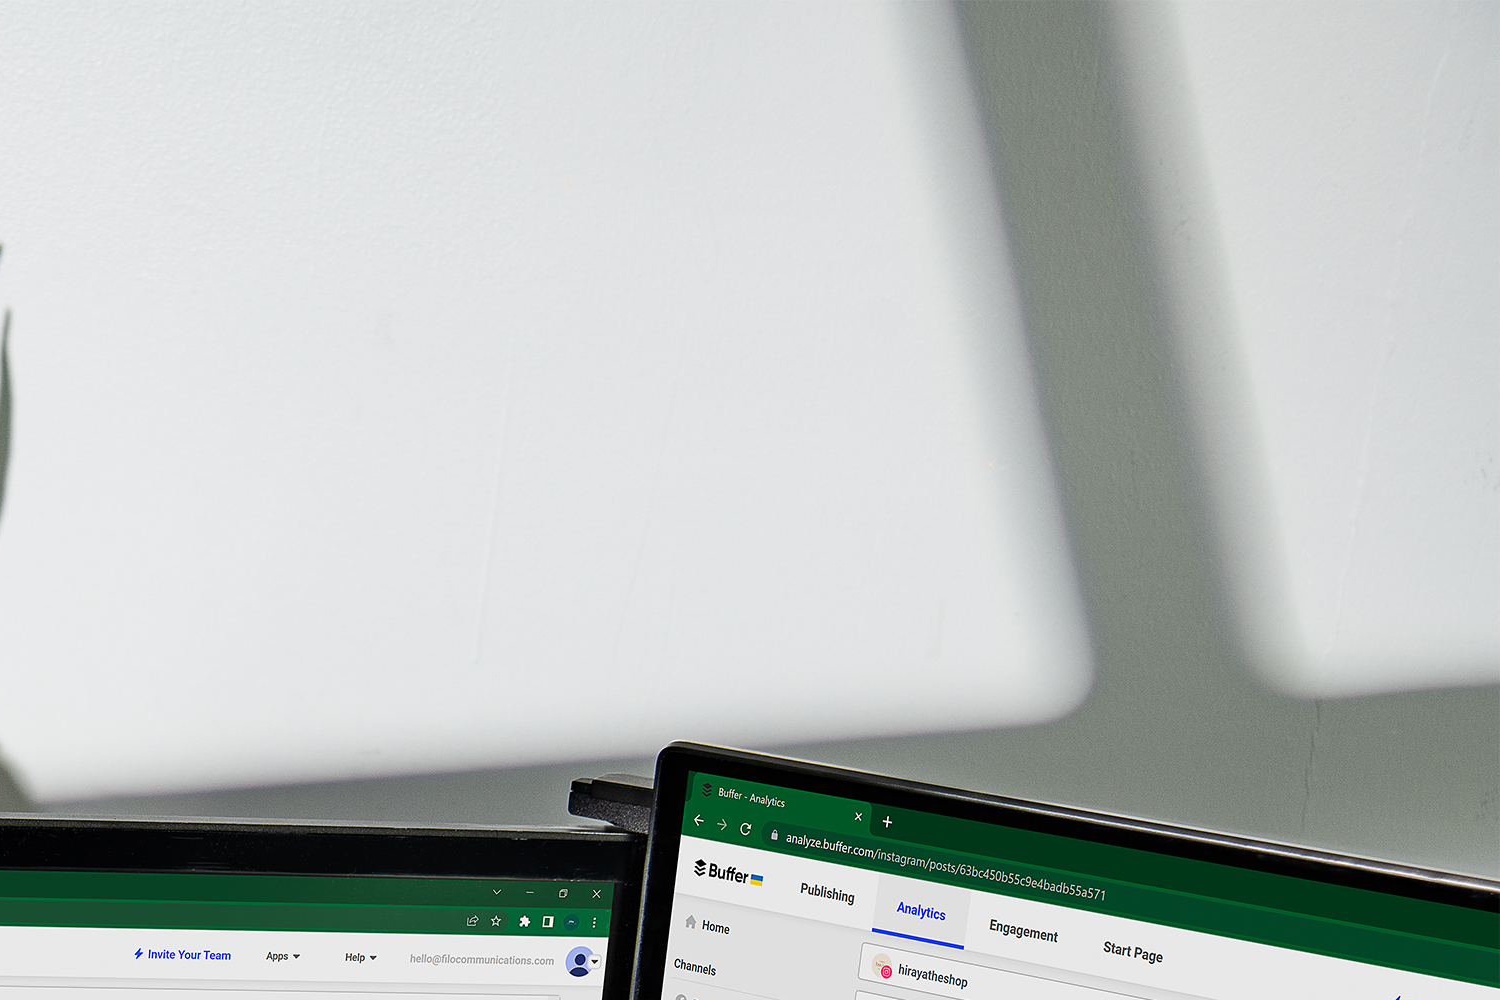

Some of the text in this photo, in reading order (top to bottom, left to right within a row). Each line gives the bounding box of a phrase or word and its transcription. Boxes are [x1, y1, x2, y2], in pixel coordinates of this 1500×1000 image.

[718, 787, 786, 808] Buffer Analytics
[708, 862, 749, 884] Buffer
[800, 882, 855, 906] Publishing
[896, 901, 947, 921] Analytics
[701, 919, 730, 935] Home
[989, 918, 1059, 943] Engagement
[147, 949, 232, 961] Invite Your Team
[265, 951, 289, 963] Apps
[345, 952, 366, 964] Help
[409, 953, 555, 966] hello@filocommunications.com
[1103, 941, 1164, 965] Start Page
[673, 958, 717, 977] Channels
[898, 963, 968, 990] hirayatheshop
